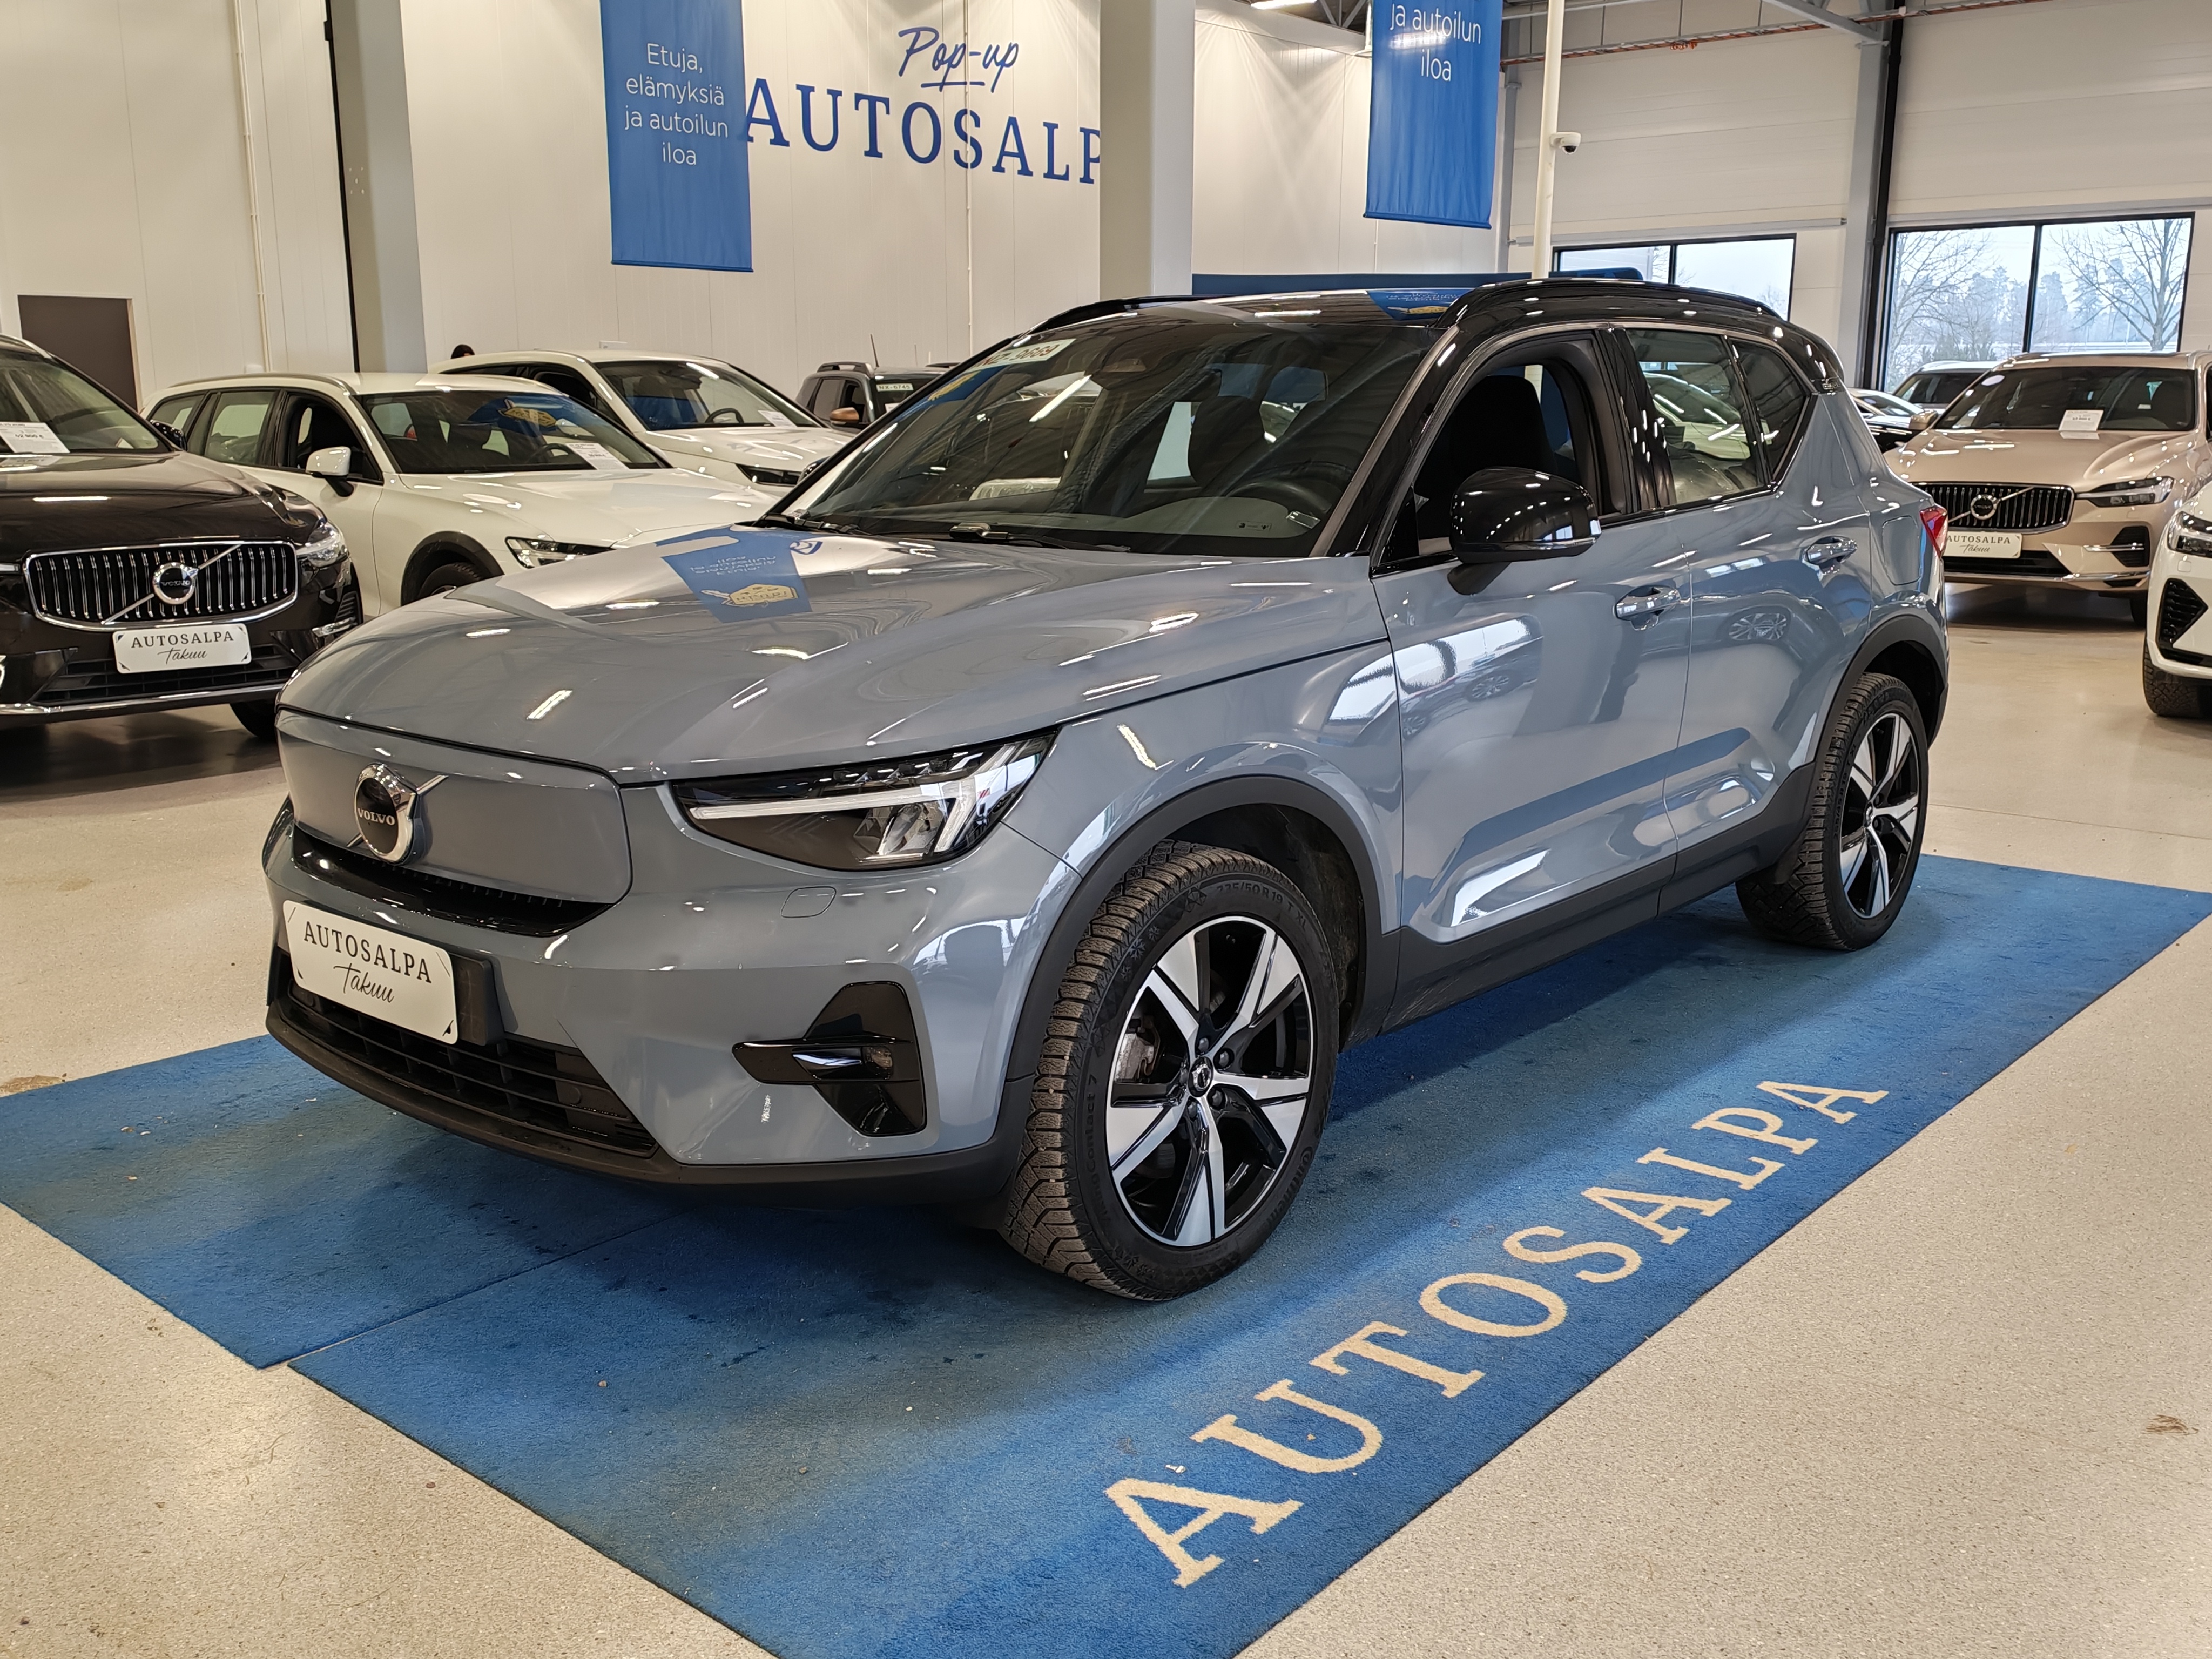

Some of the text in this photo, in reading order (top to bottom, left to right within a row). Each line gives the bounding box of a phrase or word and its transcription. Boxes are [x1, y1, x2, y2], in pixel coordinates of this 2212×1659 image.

[1390, 3, 1481, 44] ja autoilun
[646, 43, 704, 74] Etuja,
[898, 26, 1019, 93] Pop-up
[1420, 48, 1452, 82] iloa
[626, 73, 725, 106] elämyksiä
[624, 106, 729, 139] ja autoilun
[662, 141, 697, 166] iloa
[1947, 535, 2011, 544] AUTOSALPA
[1959, 544, 1991, 554] Takuu
[131, 630, 234, 649] AUTOSALPA
[157, 647, 208, 665] Takuu
[357, 807, 395, 826] VOLVO
[302, 921, 433, 984] AUTOSALPA
[333, 961, 395, 1004] Takuu
[1105, 1081, 1888, 1588] AUTOSALPA
